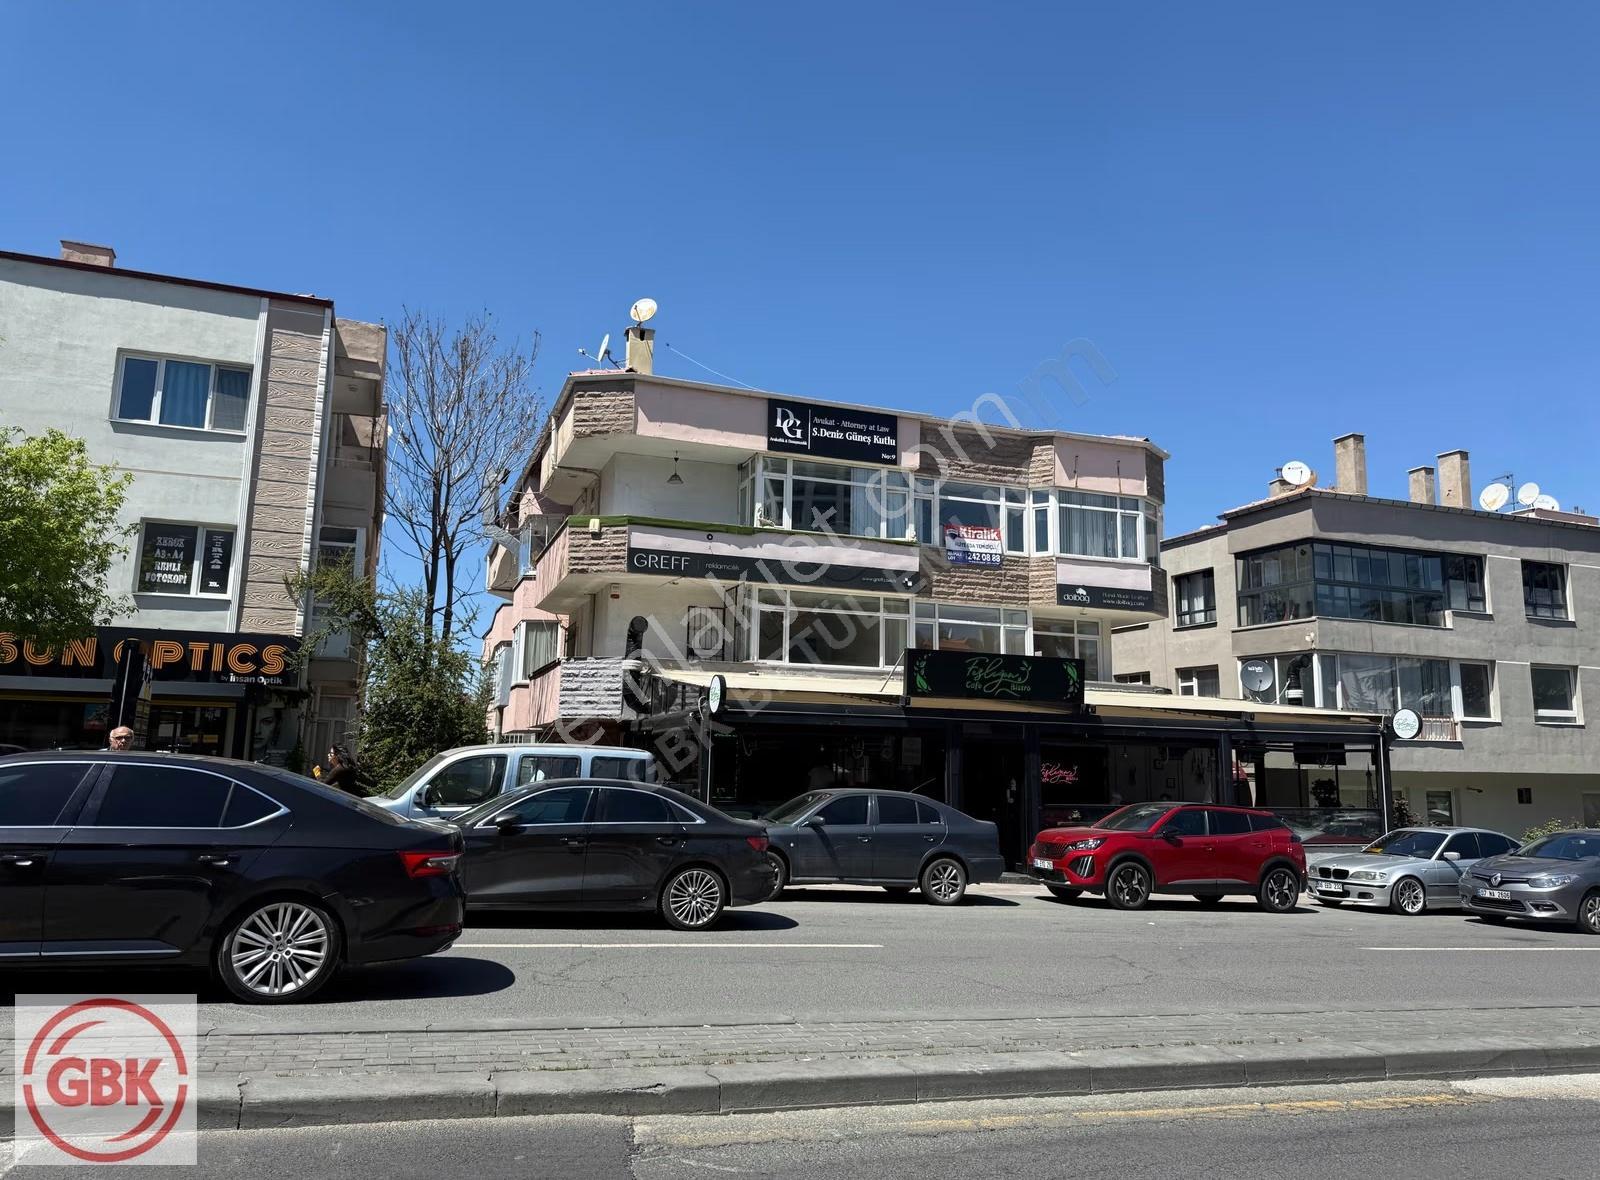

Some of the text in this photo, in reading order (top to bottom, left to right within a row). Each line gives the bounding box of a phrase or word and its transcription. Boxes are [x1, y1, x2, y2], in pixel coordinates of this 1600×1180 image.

[813, 416, 835, 426] Avukat
[841, 420, 867, 432] Attorney
[877, 425, 890, 433] Law
[812, 427, 896, 446] S.Deniz Güneş Kutlu
[881, 452, 896, 460] No:9
[154, 549, 166, 559] A3
[633, 553, 691, 571] GREFF
[145, 572, 187, 585] FOTOKOPİ
[1063, 593, 1090, 604] dolbag
[0, 632, 98, 668] SUN
[257, 675, 283, 685] Optik
